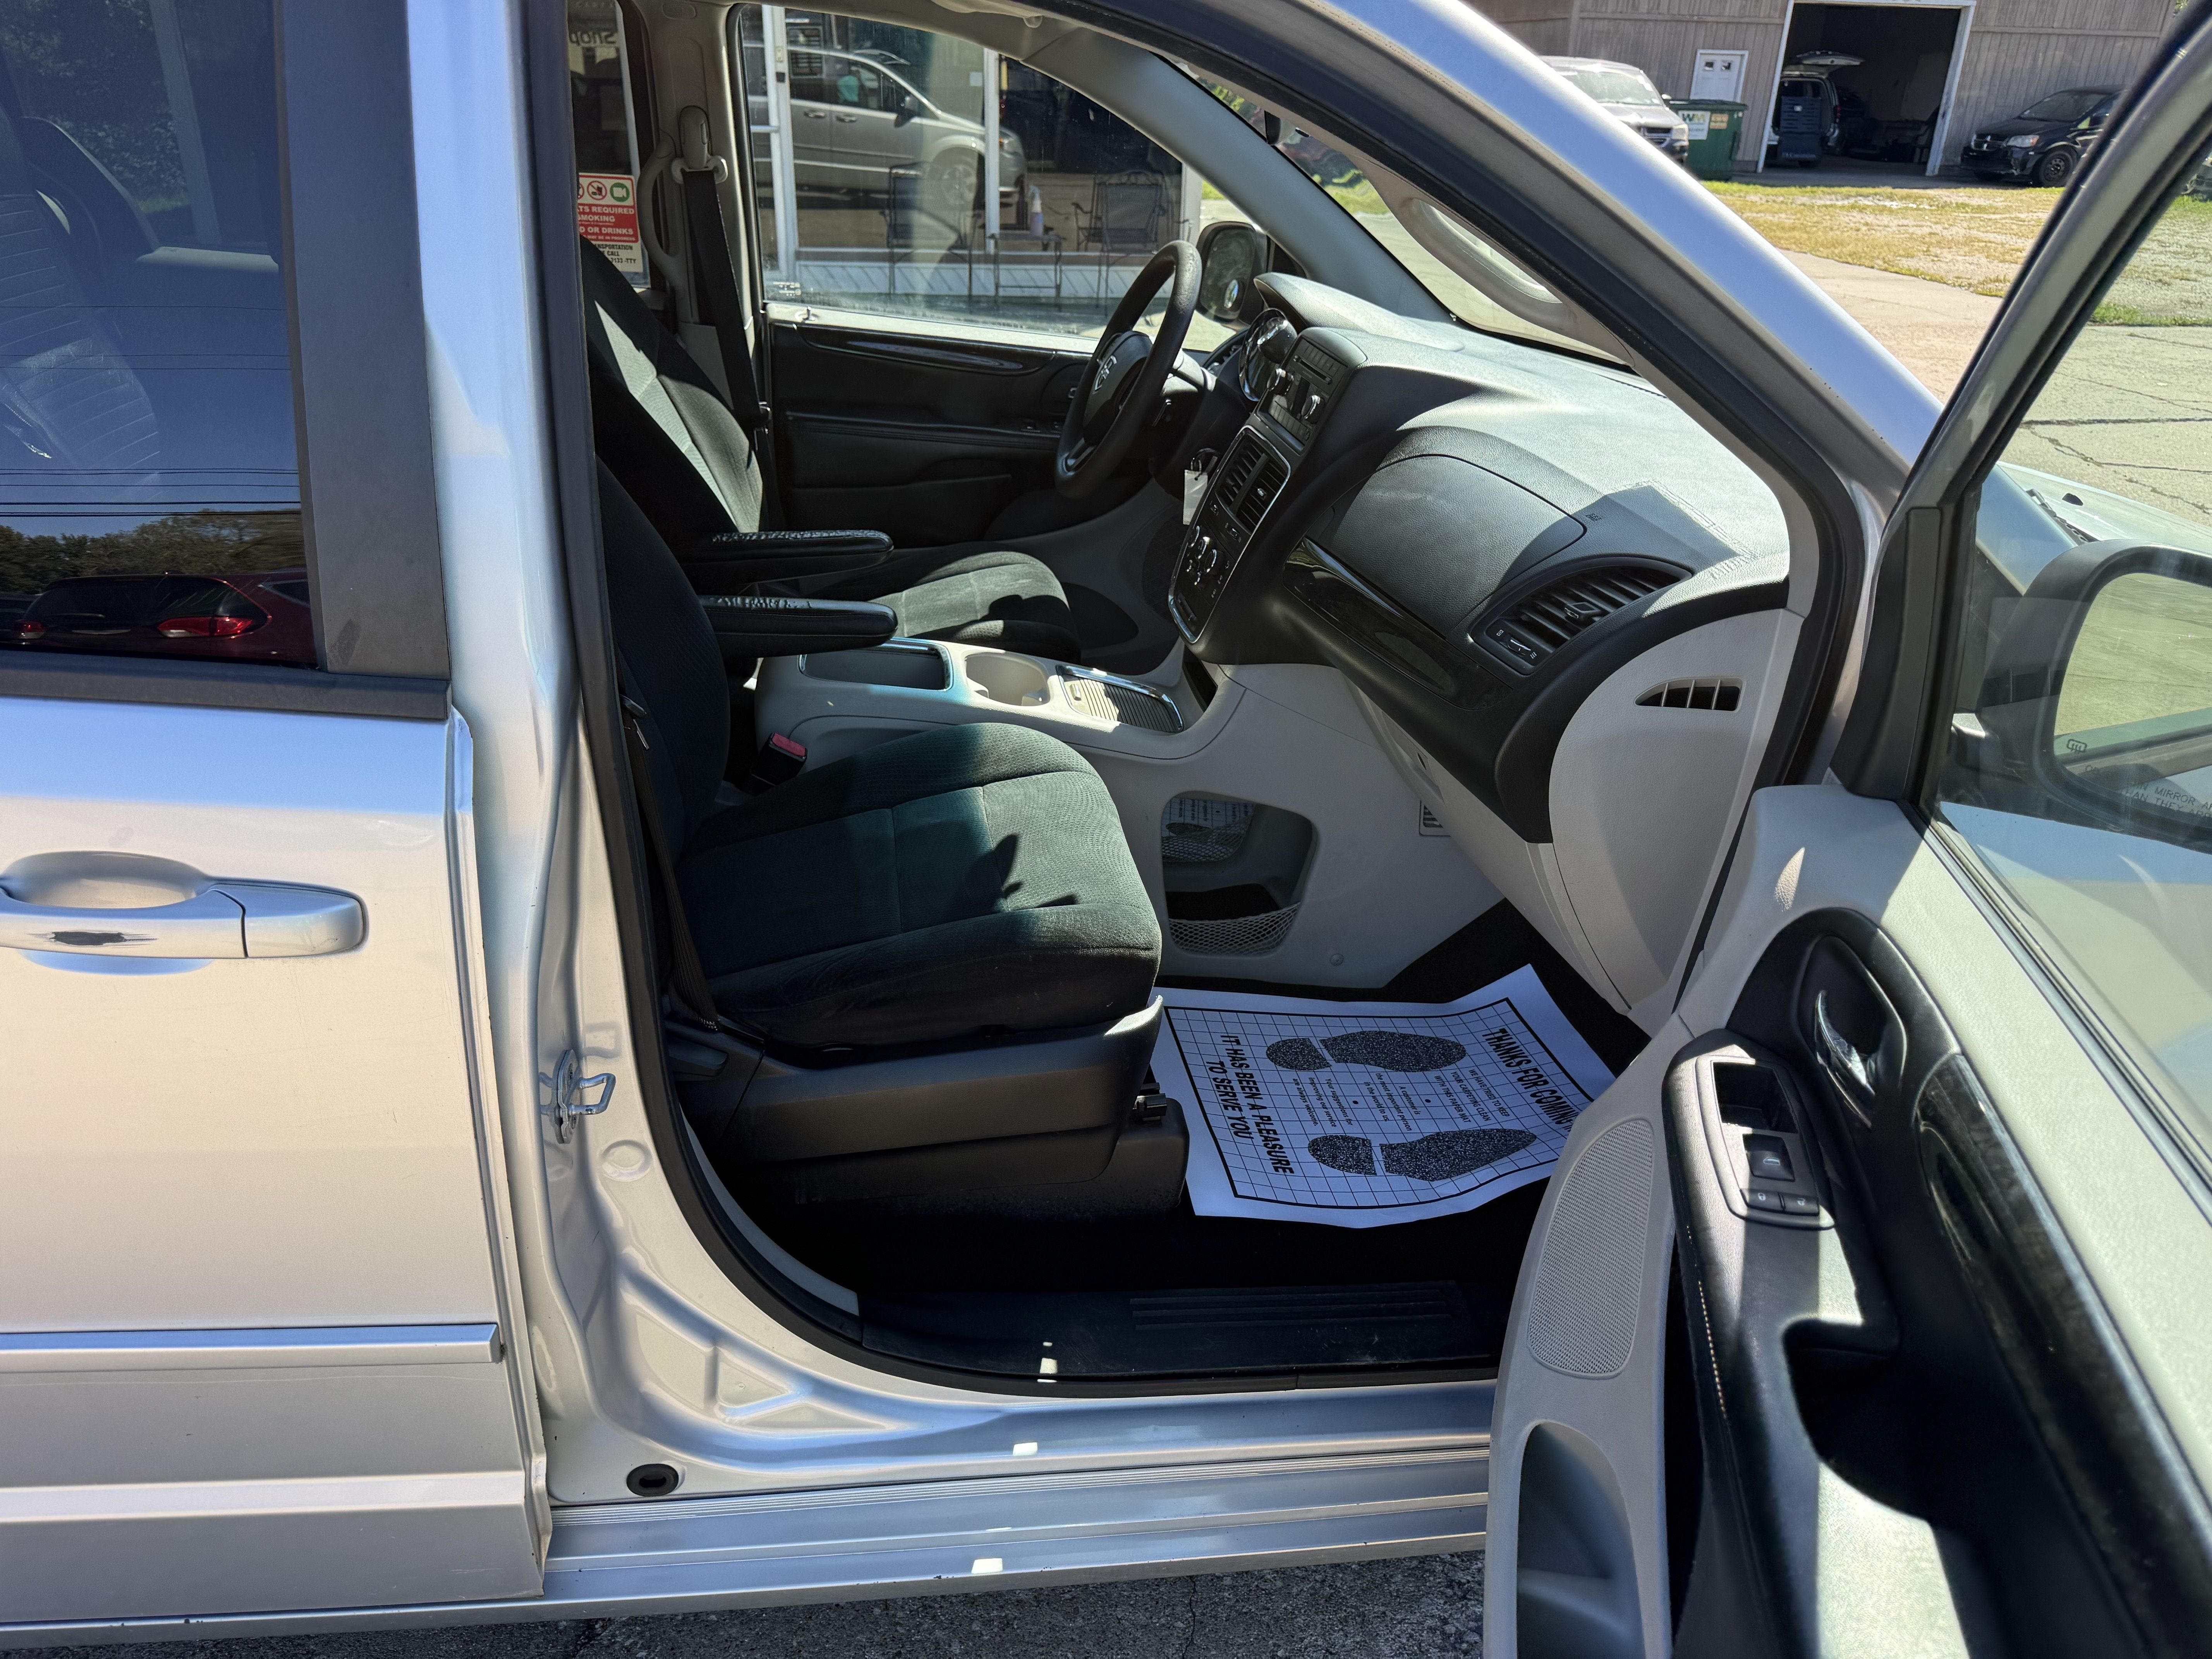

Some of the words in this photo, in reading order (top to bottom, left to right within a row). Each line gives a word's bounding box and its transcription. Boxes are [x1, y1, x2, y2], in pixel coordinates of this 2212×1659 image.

[2155, 787, 2196, 805] MIRROR
[1221, 1035, 1241, 1046] IT
[1206, 1061, 1228, 1074] TO
[1225, 1048, 1250, 1069] HAS
[1482, 1028, 1532, 1068] THANKS
[1511, 1067, 1549, 1089] FOR
[1212, 1077, 1243, 1112] SERVE
[1235, 1072, 1263, 1100] BEEN
[1297, 1087, 1308, 1103] always
[1325, 1078, 1334, 1090] Your
[1331, 1090, 1348, 1118] suggestions
[1401, 1091, 1417, 1110] customer
[1434, 1075, 1447, 1087] WITH
[1442, 1087, 1454, 1098] THIS
[1449, 1098, 1464, 1113] PAPER
[1458, 1113, 1471, 1123] MAT
[1451, 1072, 1464, 1084] YOUR
[1459, 1084, 1481, 1107] CARPETING
[1476, 1108, 1492, 1121] CLEAN
[1474, 1076, 1487, 1088] HAVE
[1482, 1087, 1497, 1100] TRIED
[1496, 1106, 1510, 1117] KEEP
[1308, 1077, 1323, 1101] improving
[1320, 1102, 1328, 1110] our
[1324, 1110, 1337, 1127] service
[1372, 1096, 1384, 1108] world
[1379, 1081, 1390, 1092] most
[1386, 1093, 1403, 1114] important
[1397, 1115, 1412, 1131] person
[1228, 1116, 1254, 1139] YOU
[1252, 1115, 1295, 1174] PLEASURE
